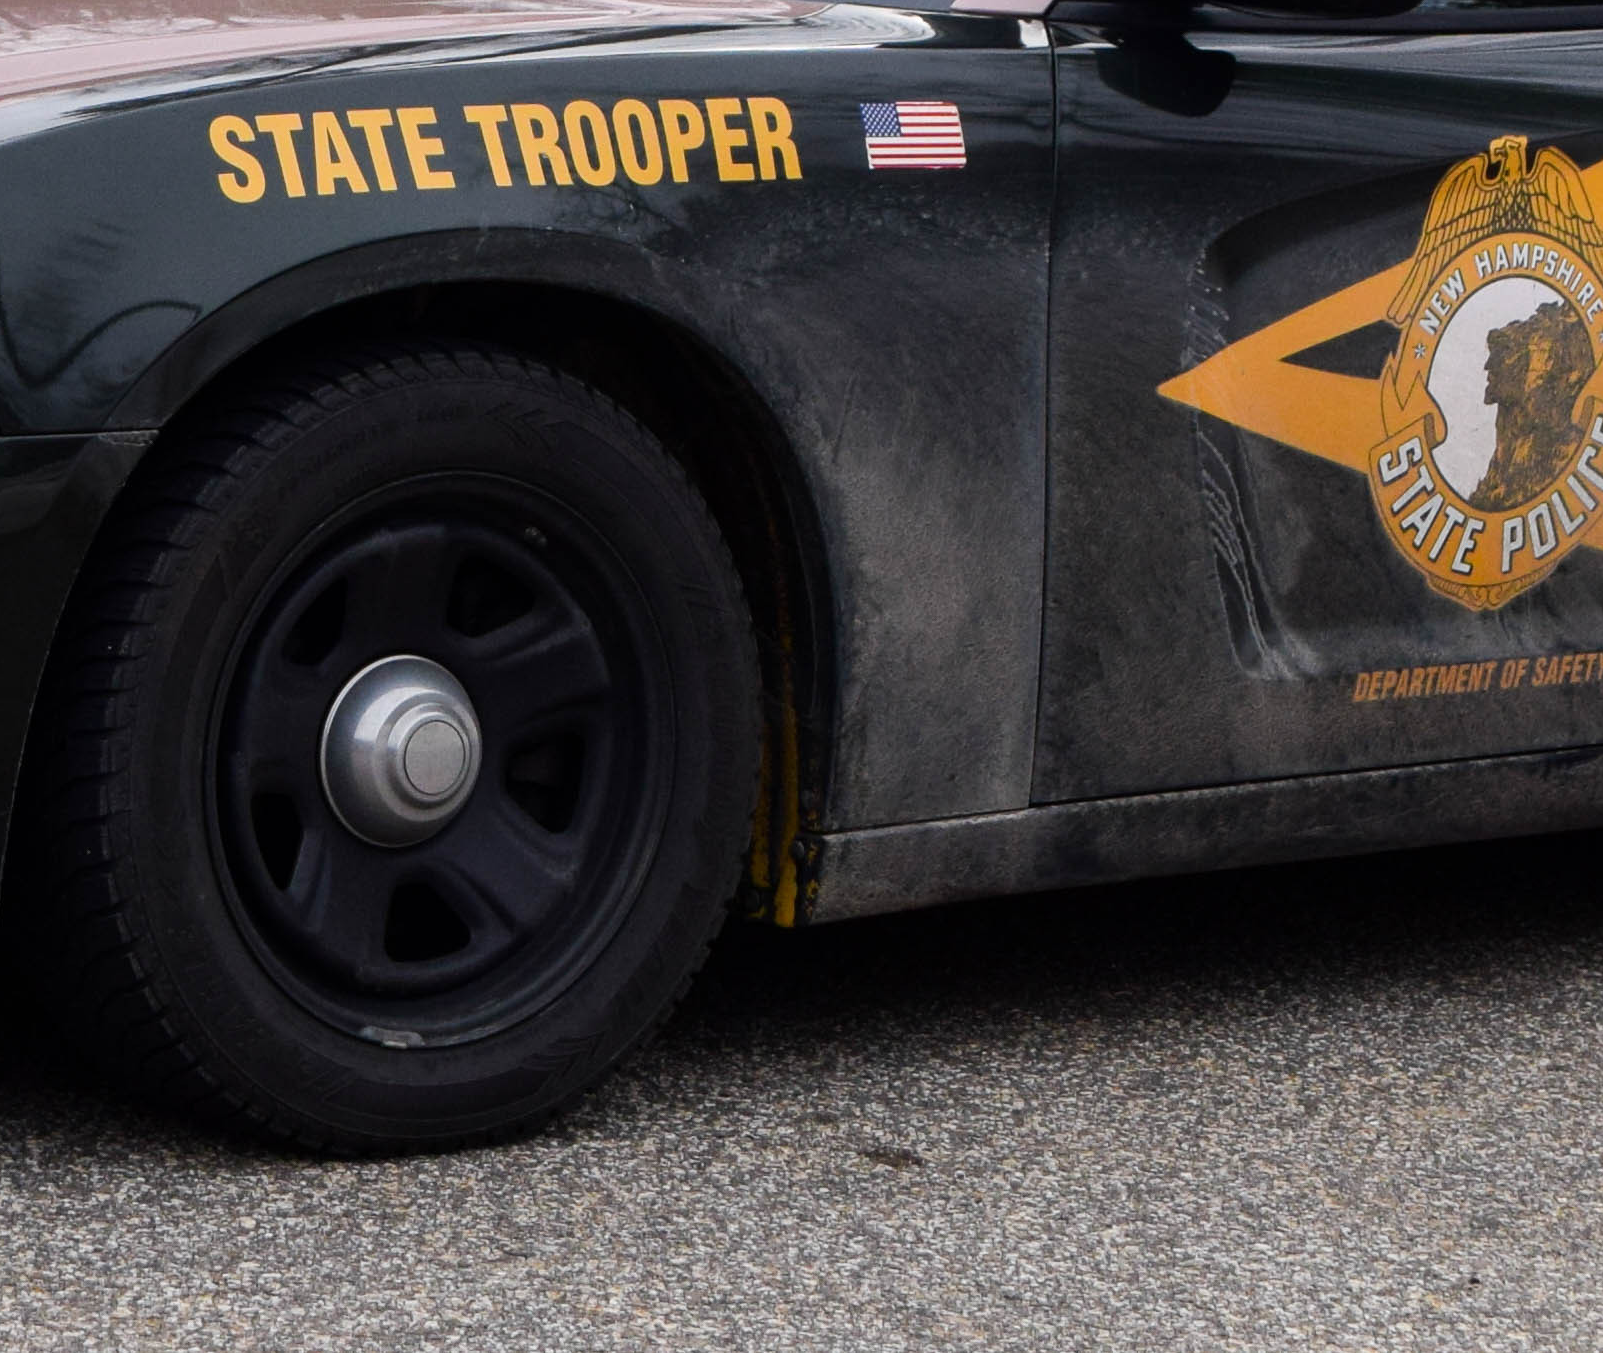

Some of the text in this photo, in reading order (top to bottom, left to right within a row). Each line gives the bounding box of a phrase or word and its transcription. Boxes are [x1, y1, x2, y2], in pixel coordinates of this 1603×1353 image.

[209, 96, 804, 203] STATE TROOPER
[1418, 241, 1603, 336] NEW HAMPSHIRE
[1378, 436, 1485, 575] STATE
[1352, 662, 1497, 702] DEPARTMENT
[1500, 659, 1526, 690] OF
